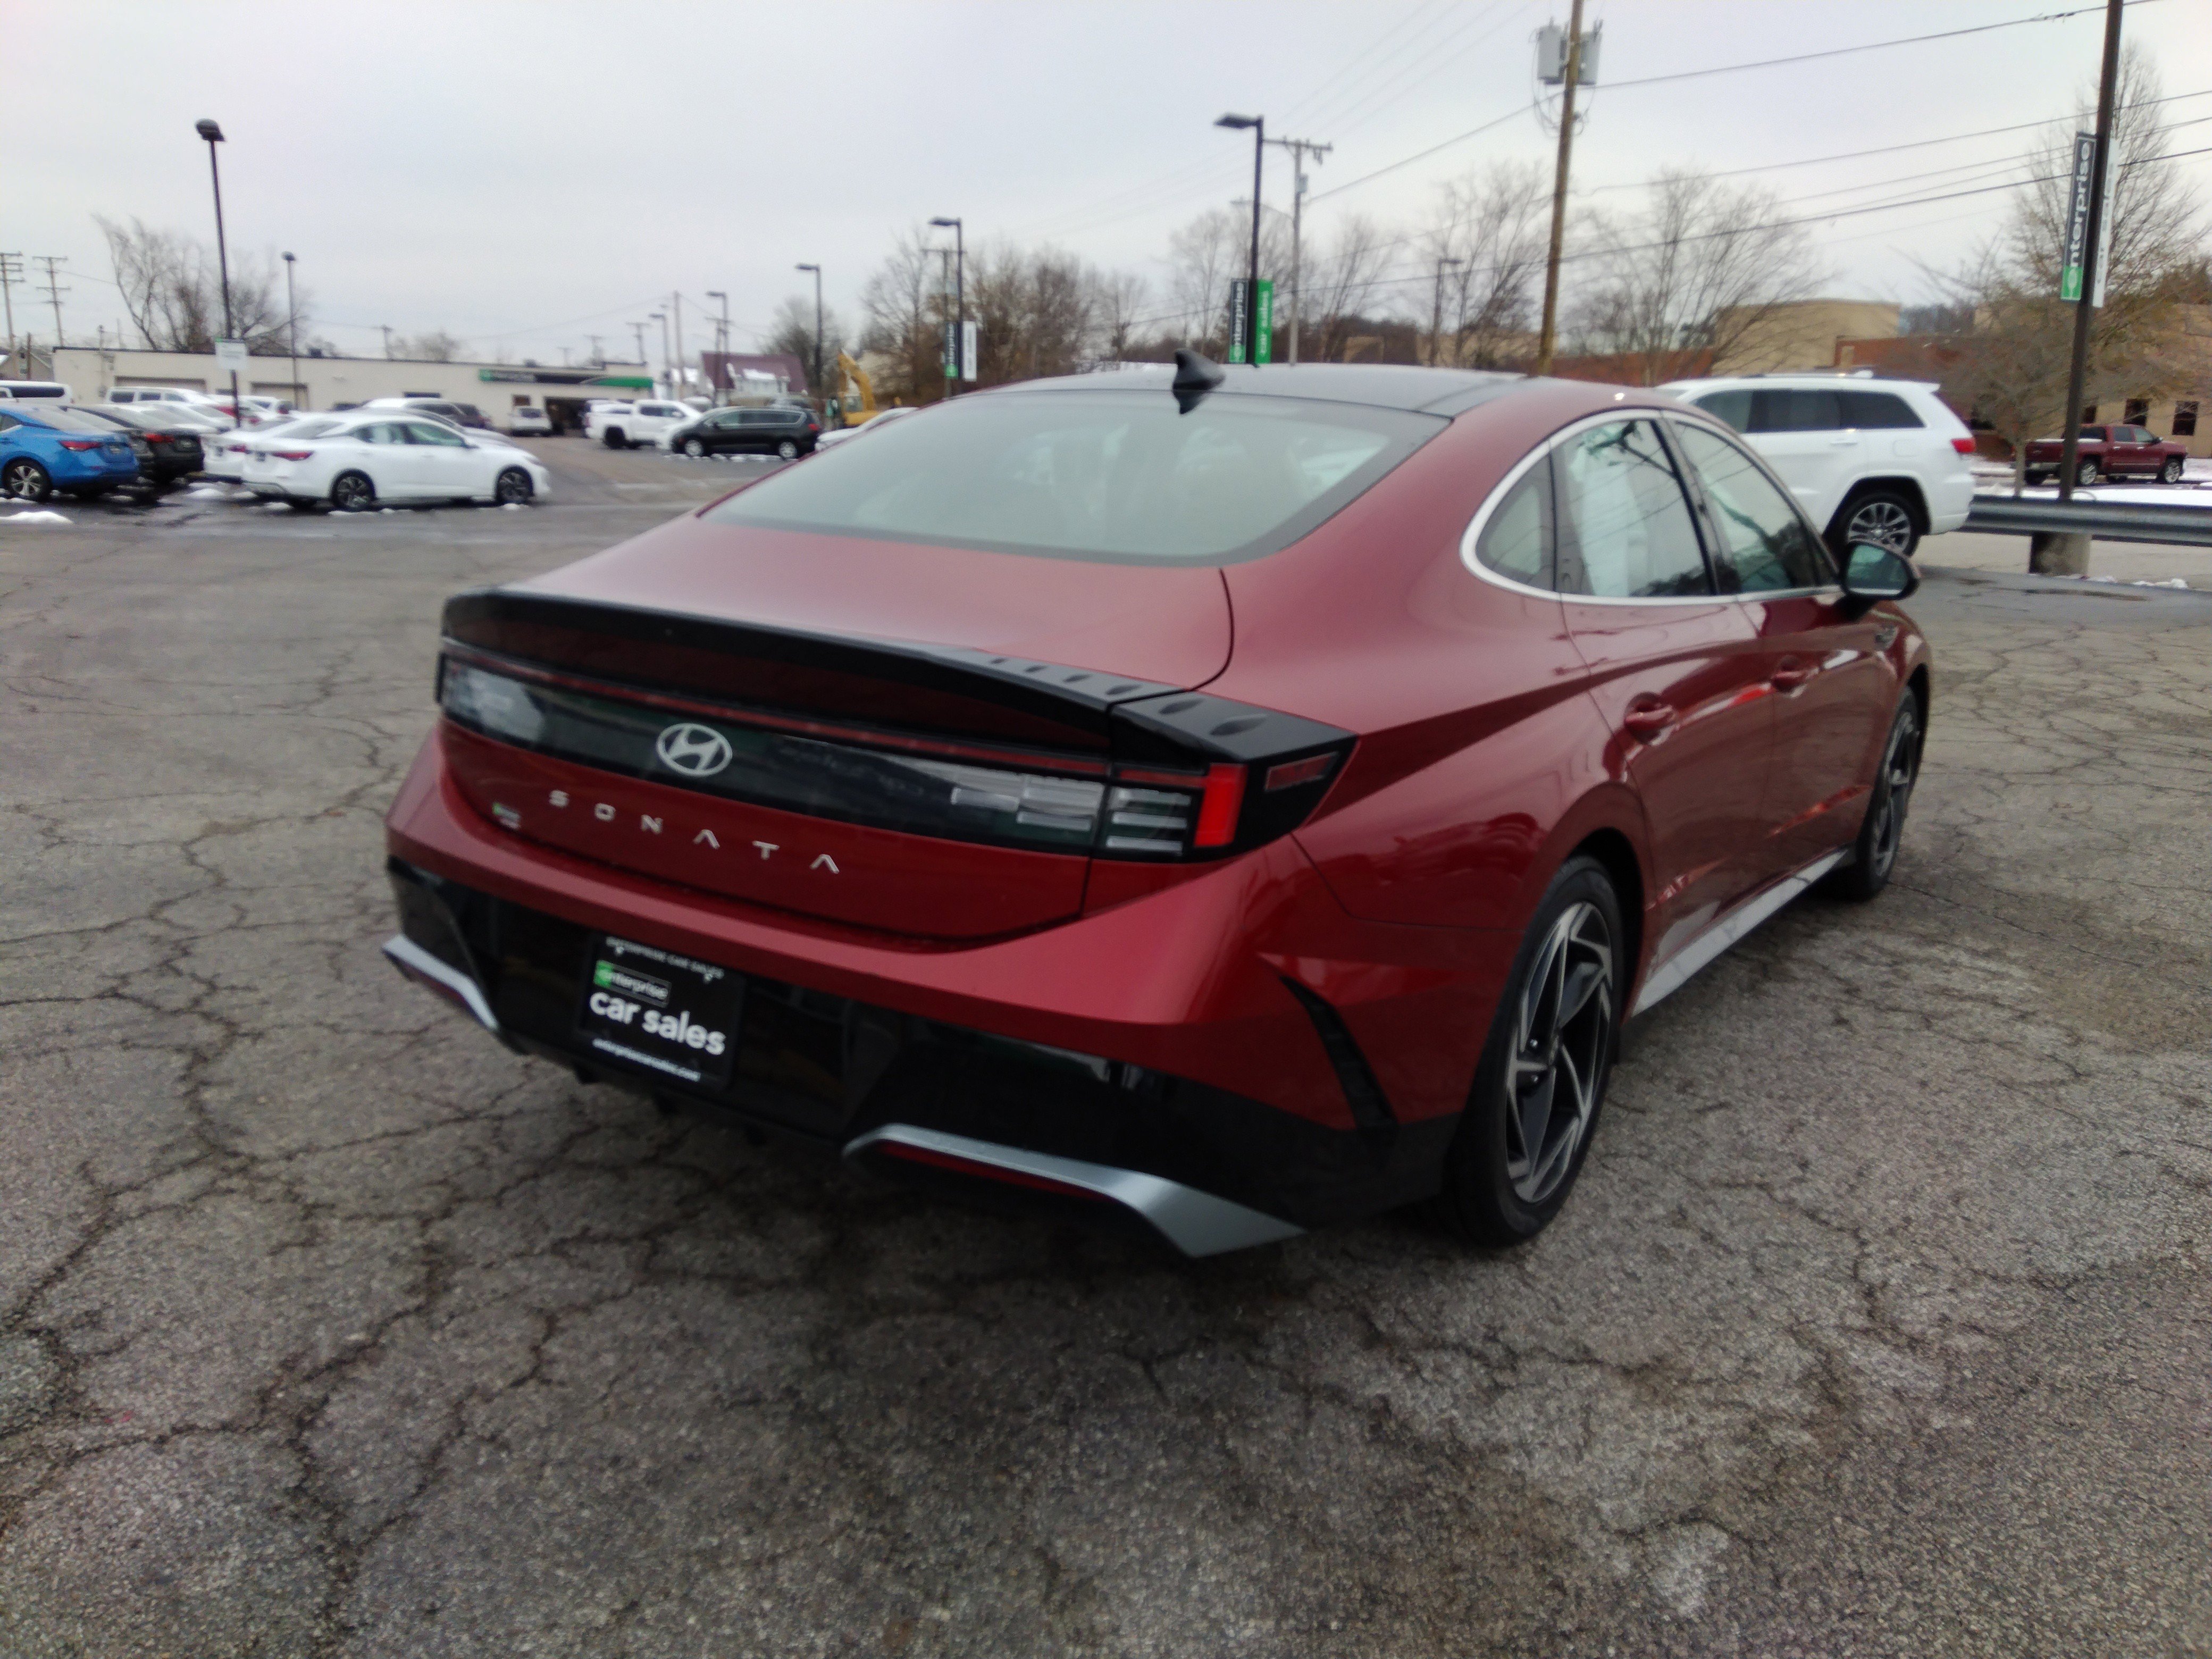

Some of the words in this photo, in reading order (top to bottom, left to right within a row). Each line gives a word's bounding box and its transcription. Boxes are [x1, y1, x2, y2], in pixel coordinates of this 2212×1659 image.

[2067, 141, 2091, 298] enterprise
[549, 790, 840, 874] SONATA
[589, 991, 641, 1025] car
[641, 1010, 726, 1056] sales
